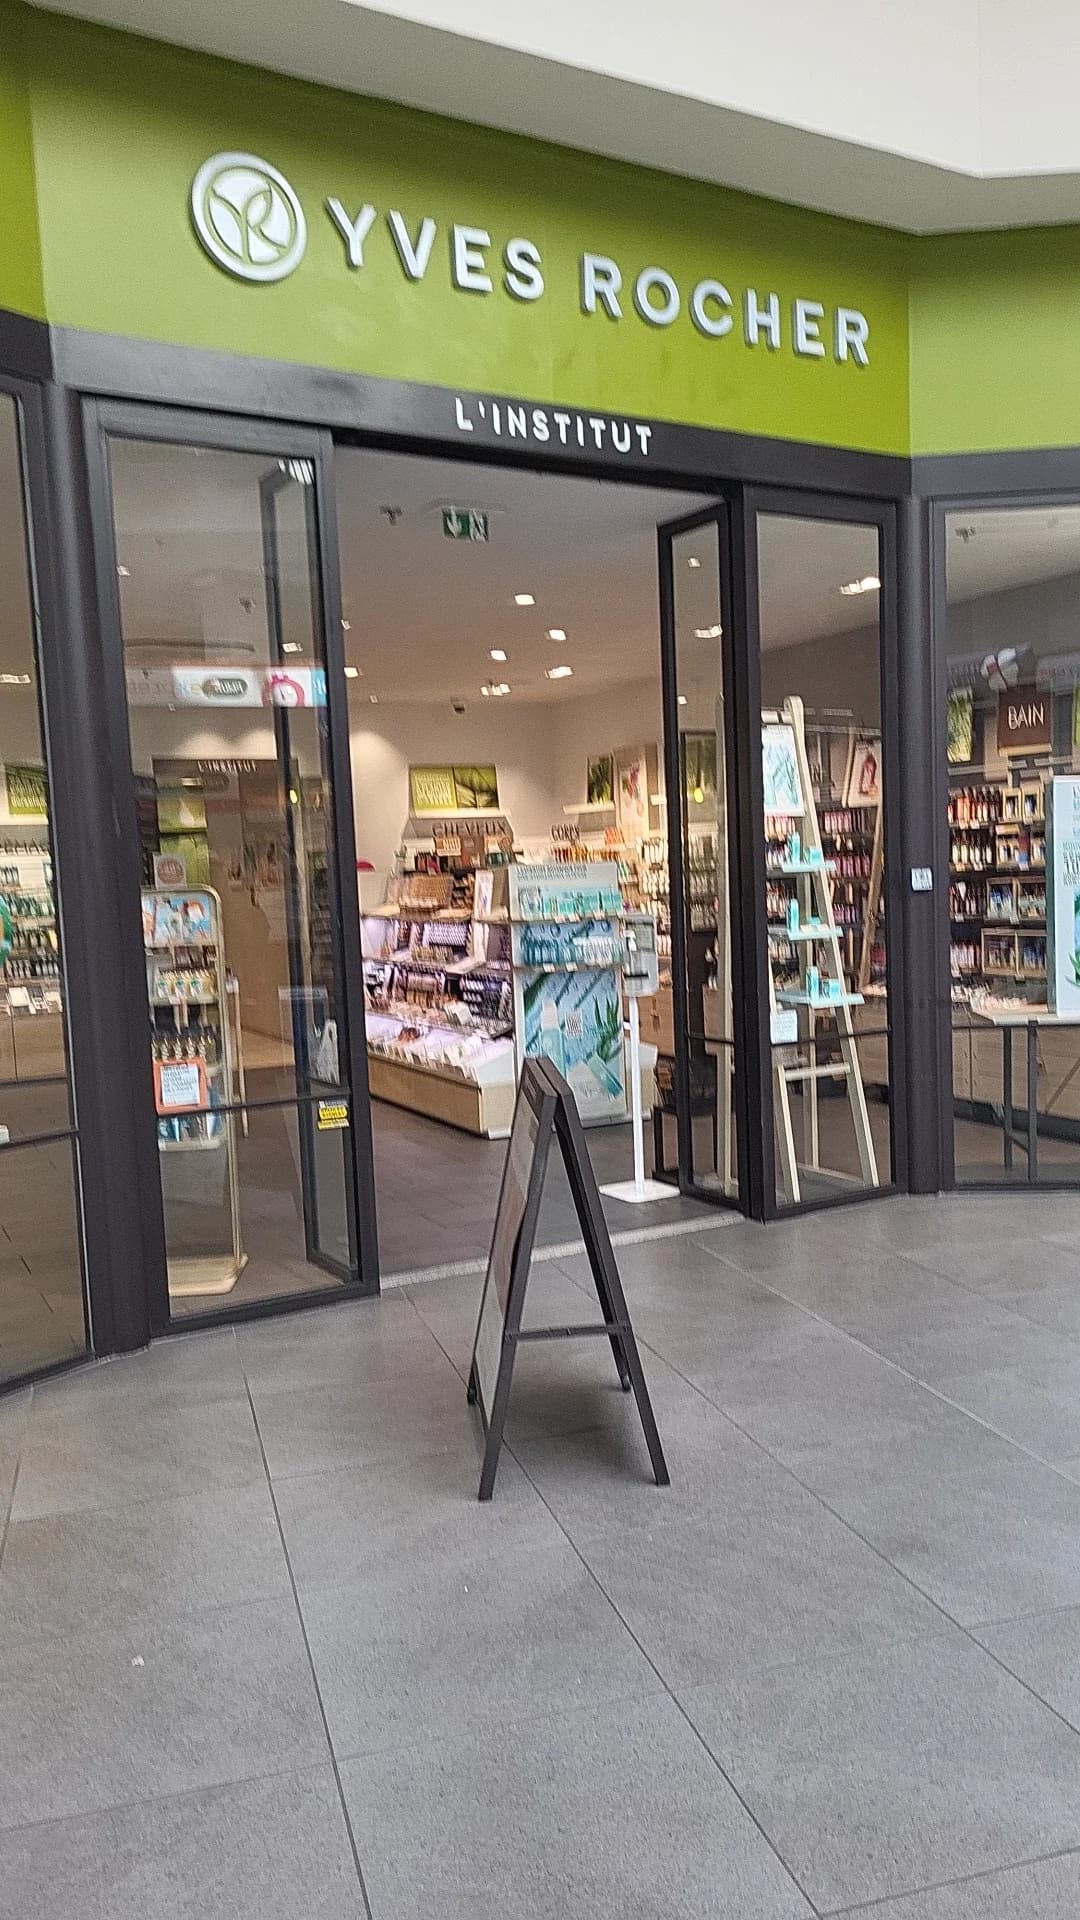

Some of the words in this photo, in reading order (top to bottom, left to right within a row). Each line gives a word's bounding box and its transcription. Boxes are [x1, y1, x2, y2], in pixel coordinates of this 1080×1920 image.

[324, 196, 545, 300] YVES
[581, 250, 870, 366] ROCHER
[455, 398, 651, 455] L'INSTITUT
[1008, 702, 1044, 730] BAIN
